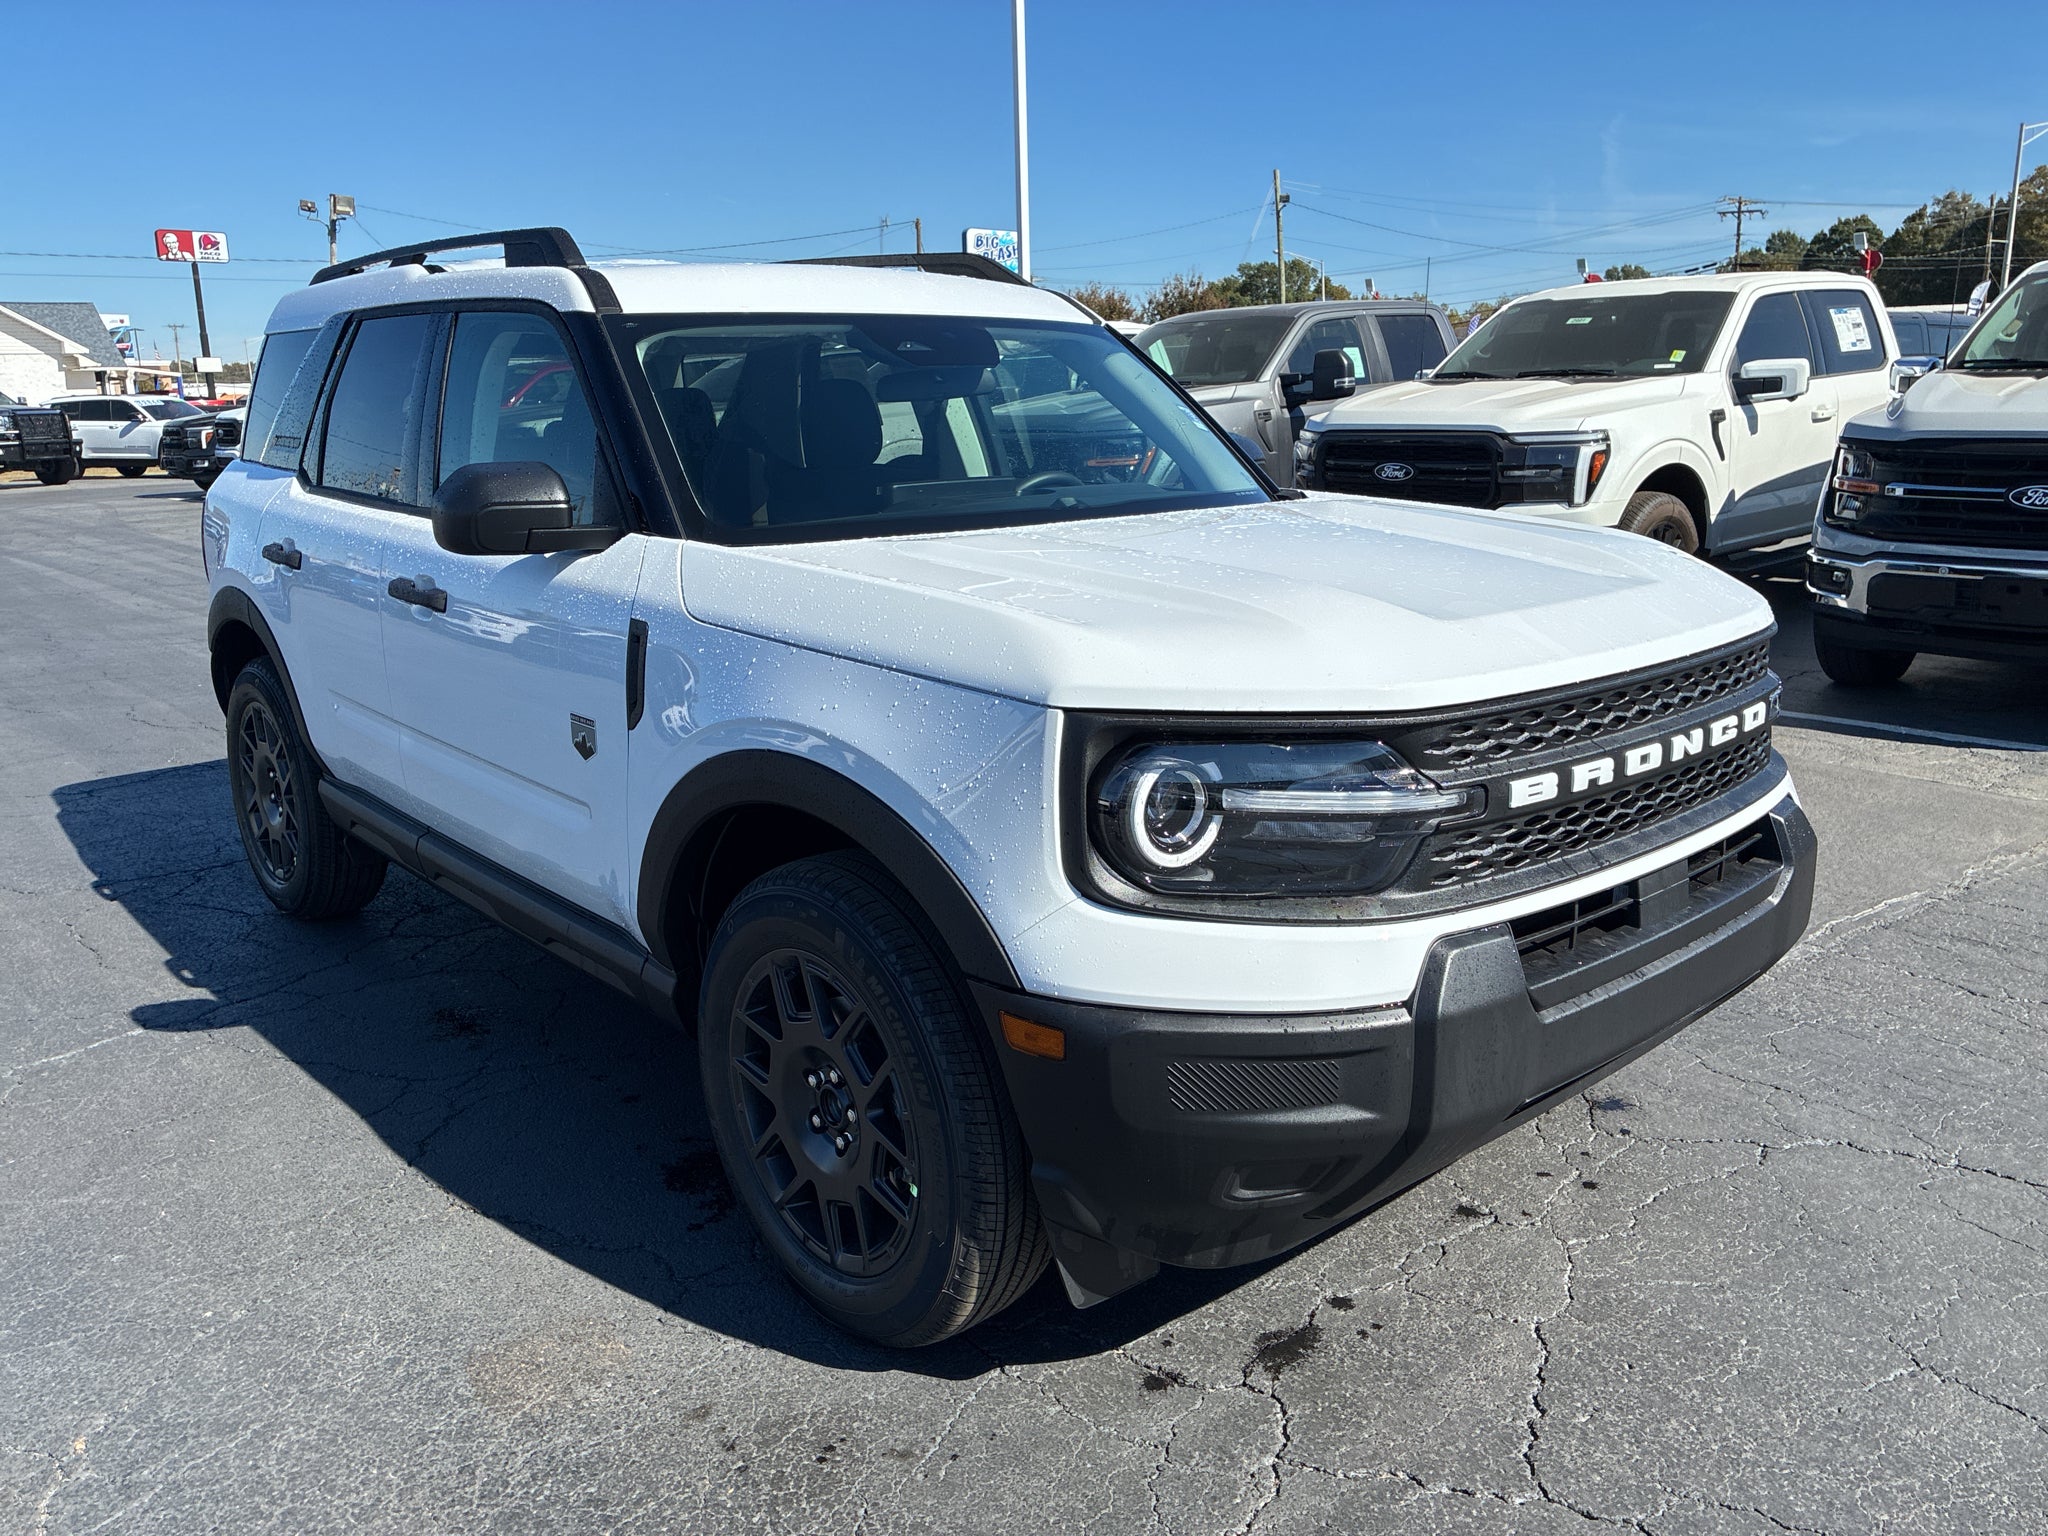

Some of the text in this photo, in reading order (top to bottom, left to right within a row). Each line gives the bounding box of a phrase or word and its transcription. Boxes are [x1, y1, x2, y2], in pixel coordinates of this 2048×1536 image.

[975, 235, 999, 249] BIG
[1380, 464, 1407, 478] Ford
[1508, 701, 1767, 809] BRONCO
[866, 975, 932, 1103] MICHELIN
